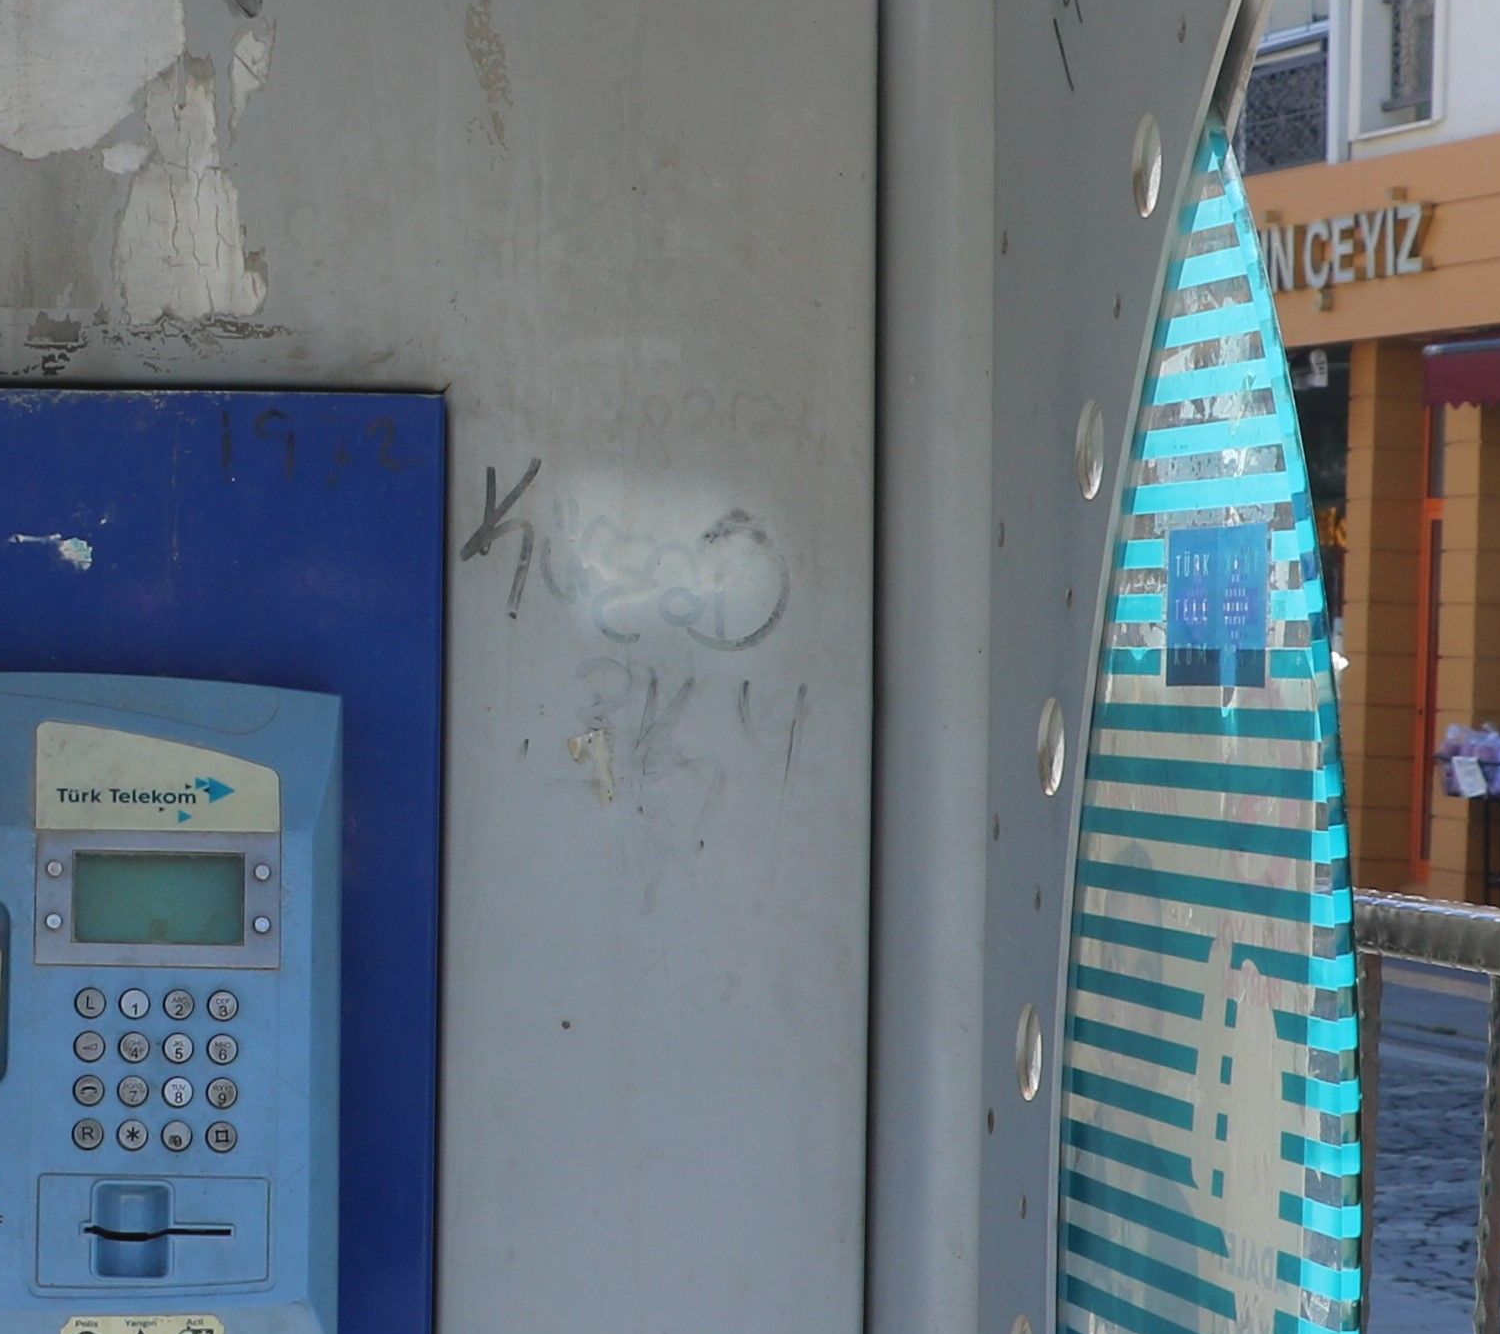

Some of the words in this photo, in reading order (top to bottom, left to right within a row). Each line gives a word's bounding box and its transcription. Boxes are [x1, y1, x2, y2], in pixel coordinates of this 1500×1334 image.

[1303, 187, 1424, 313] ÇEYİZ
[56, 788, 102, 804] Türk
[109, 788, 197, 805] Telekom
[86, 996, 95, 1010] L
[132, 1003, 139, 1015] 1
[175, 1004, 184, 1017] 2
[219, 1005, 228, 1018] 3
[131, 1047, 139, 1059] 4
[175, 1047, 183, 1060] 5
[218, 1048, 227, 1061] 6
[130, 1090, 138, 1102] 7
[175, 1092, 183, 1104] 8
[218, 1092, 227, 1106] 9
[82, 1126, 95, 1141] R
[75, 1319, 99, 1328] Polis
